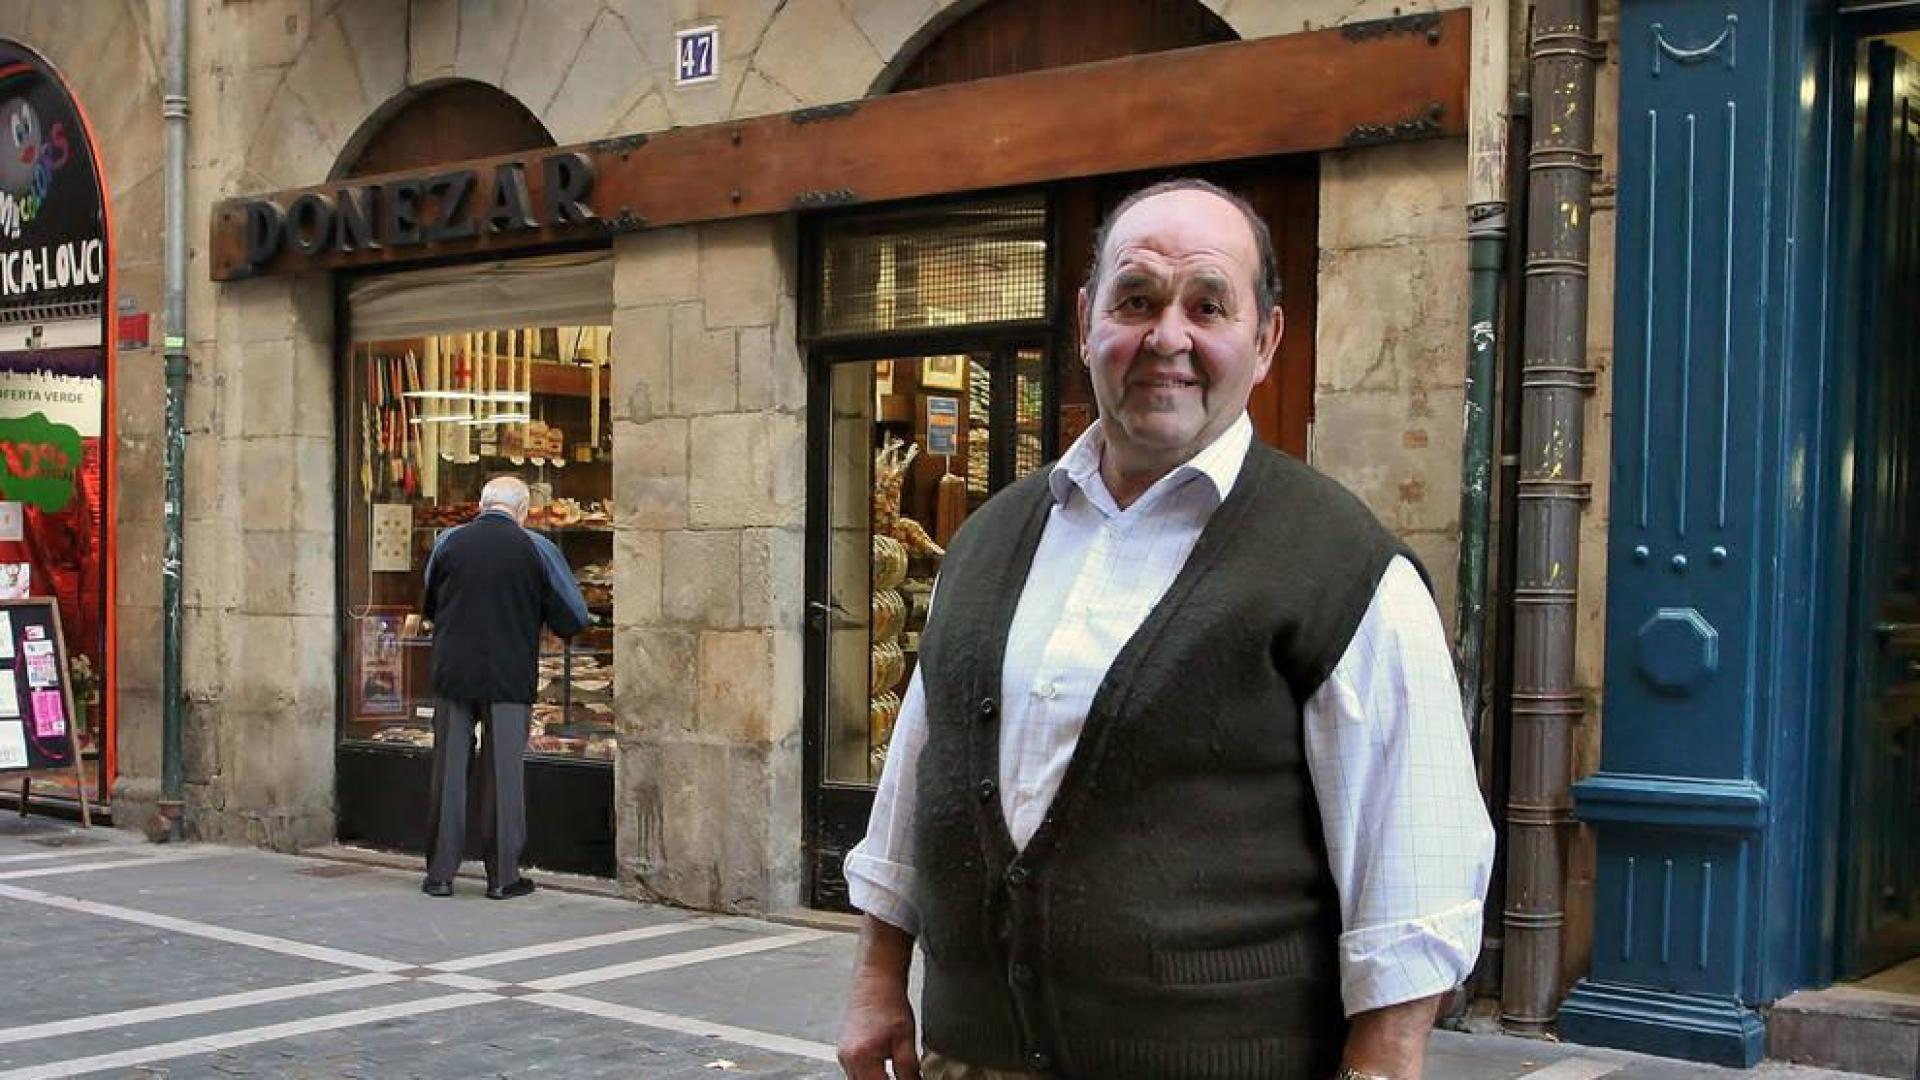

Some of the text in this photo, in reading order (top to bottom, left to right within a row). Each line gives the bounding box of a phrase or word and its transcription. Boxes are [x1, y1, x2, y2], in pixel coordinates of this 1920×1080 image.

[682, 36, 711, 76] 47
[246, 152, 595, 268] DONEZAR
[0, 388, 84, 404] FERTA VERDE
